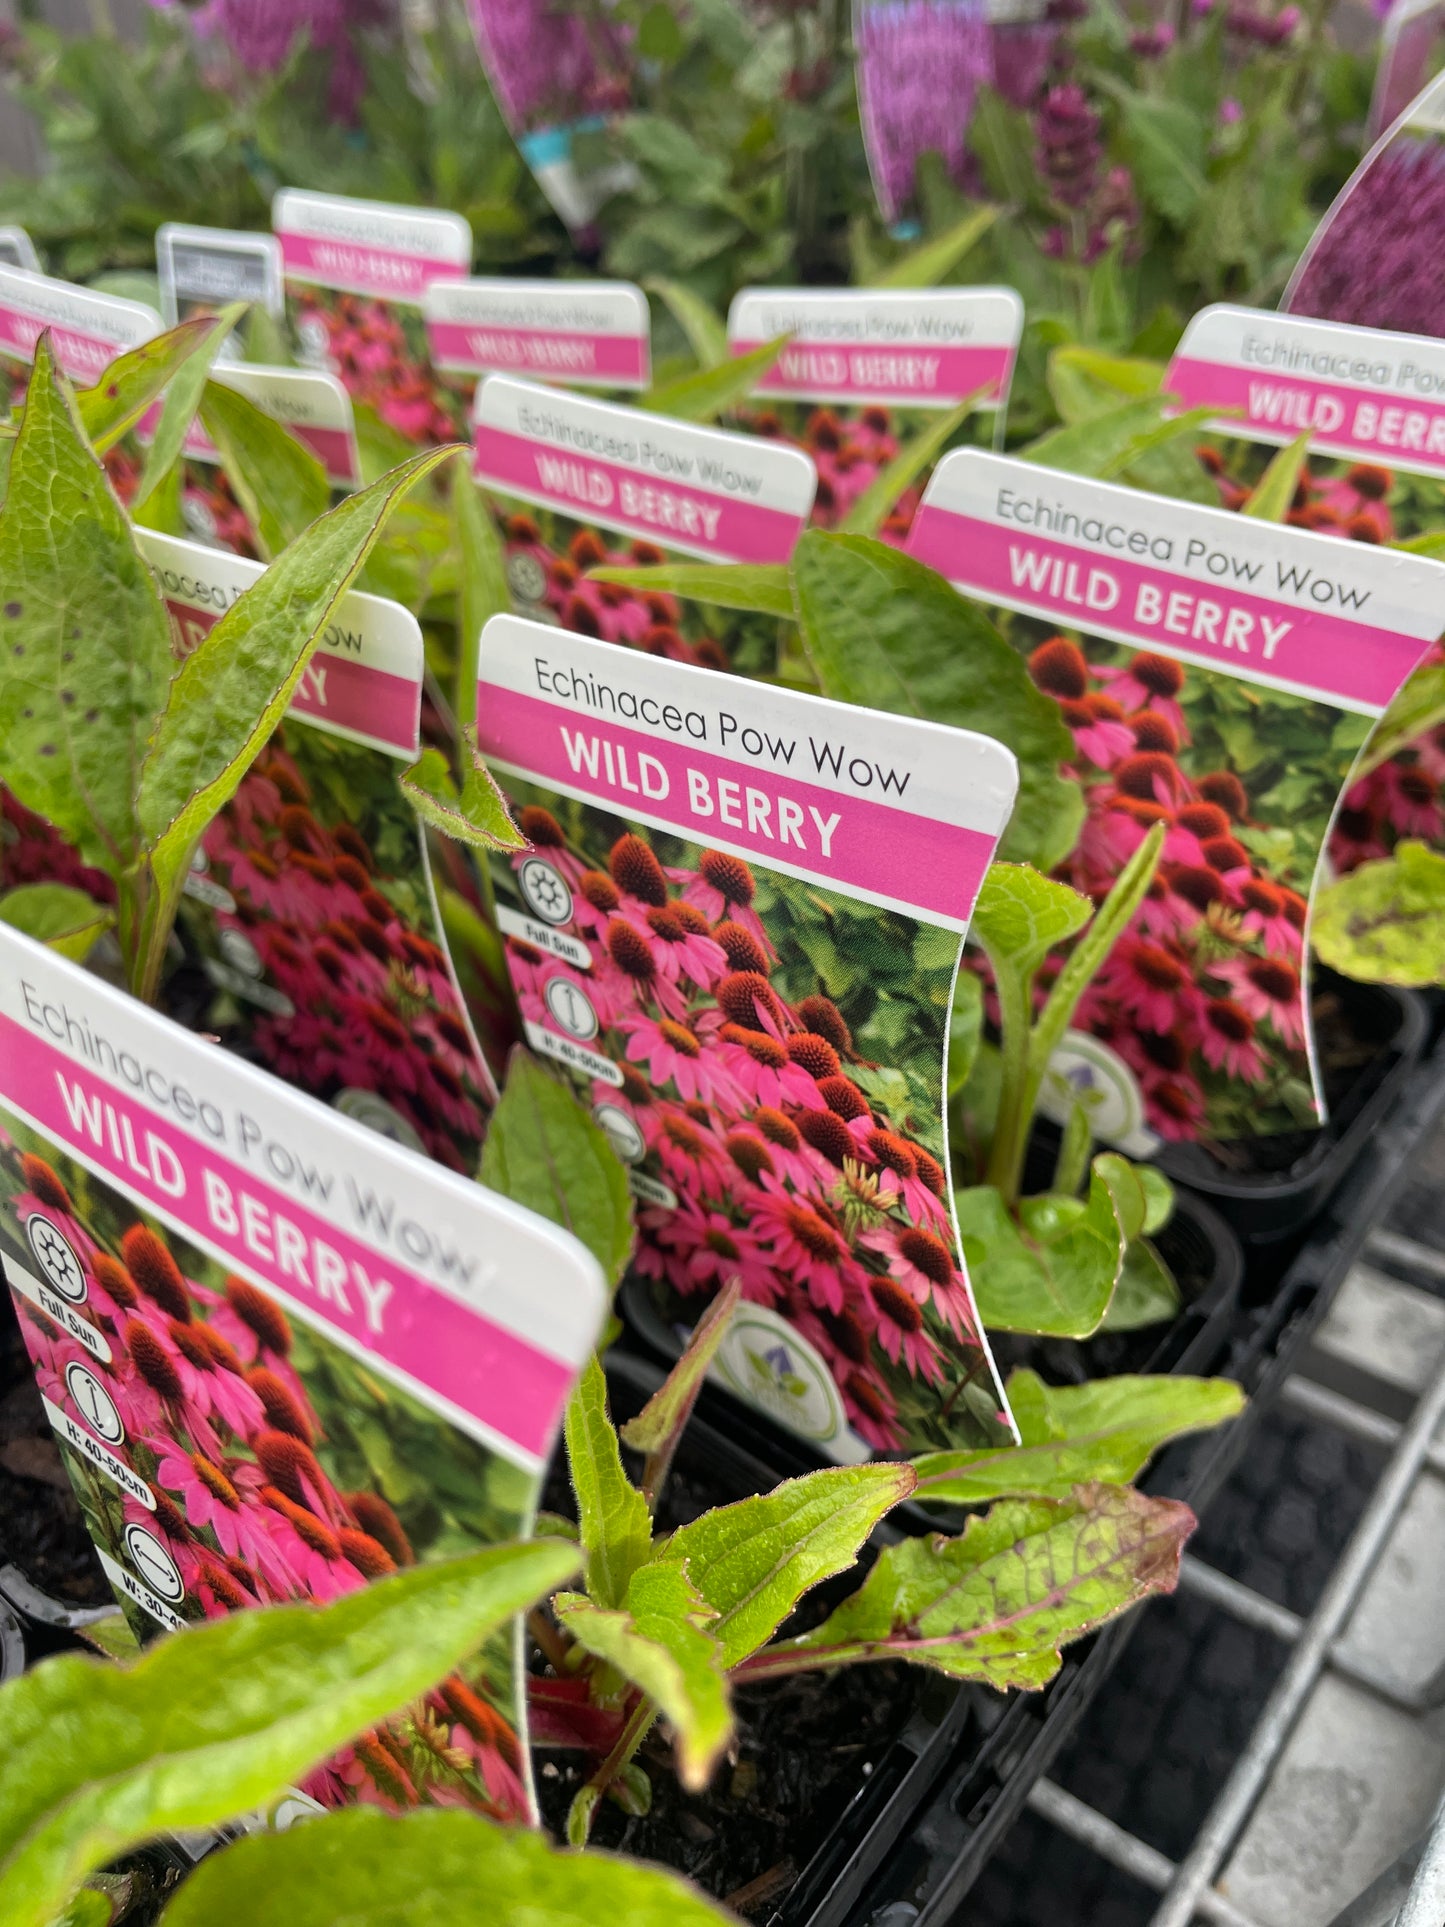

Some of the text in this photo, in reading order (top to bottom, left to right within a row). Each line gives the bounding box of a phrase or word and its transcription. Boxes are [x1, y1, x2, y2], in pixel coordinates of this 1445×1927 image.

[778, 350, 941, 389] WILD BERRY
[1241, 334, 1392, 385] Echinacea
[517, 404, 763, 496] Echinacea Pow Wow
[1248, 381, 1445, 457] WILD BERR
[535, 453, 722, 541] WILD BERRY
[996, 488, 1372, 611] Echinacea Pow Wow
[324, 624, 363, 653] ow
[1008, 545, 1293, 661] WILD BERRY
[534, 657, 911, 797] Echinacea Pow Wow
[559, 726, 842, 858] WILD BERRY
[525, 922, 579, 960] Full Sun
[20, 978, 482, 1288] Echinacea Pow Wow
[54, 1069, 396, 1335] WILD BERRY
[37, 1286, 99, 1350] Full Sun
[66, 1419, 150, 1503] H: 40-50cm
[121, 1571, 142, 1601] W:
